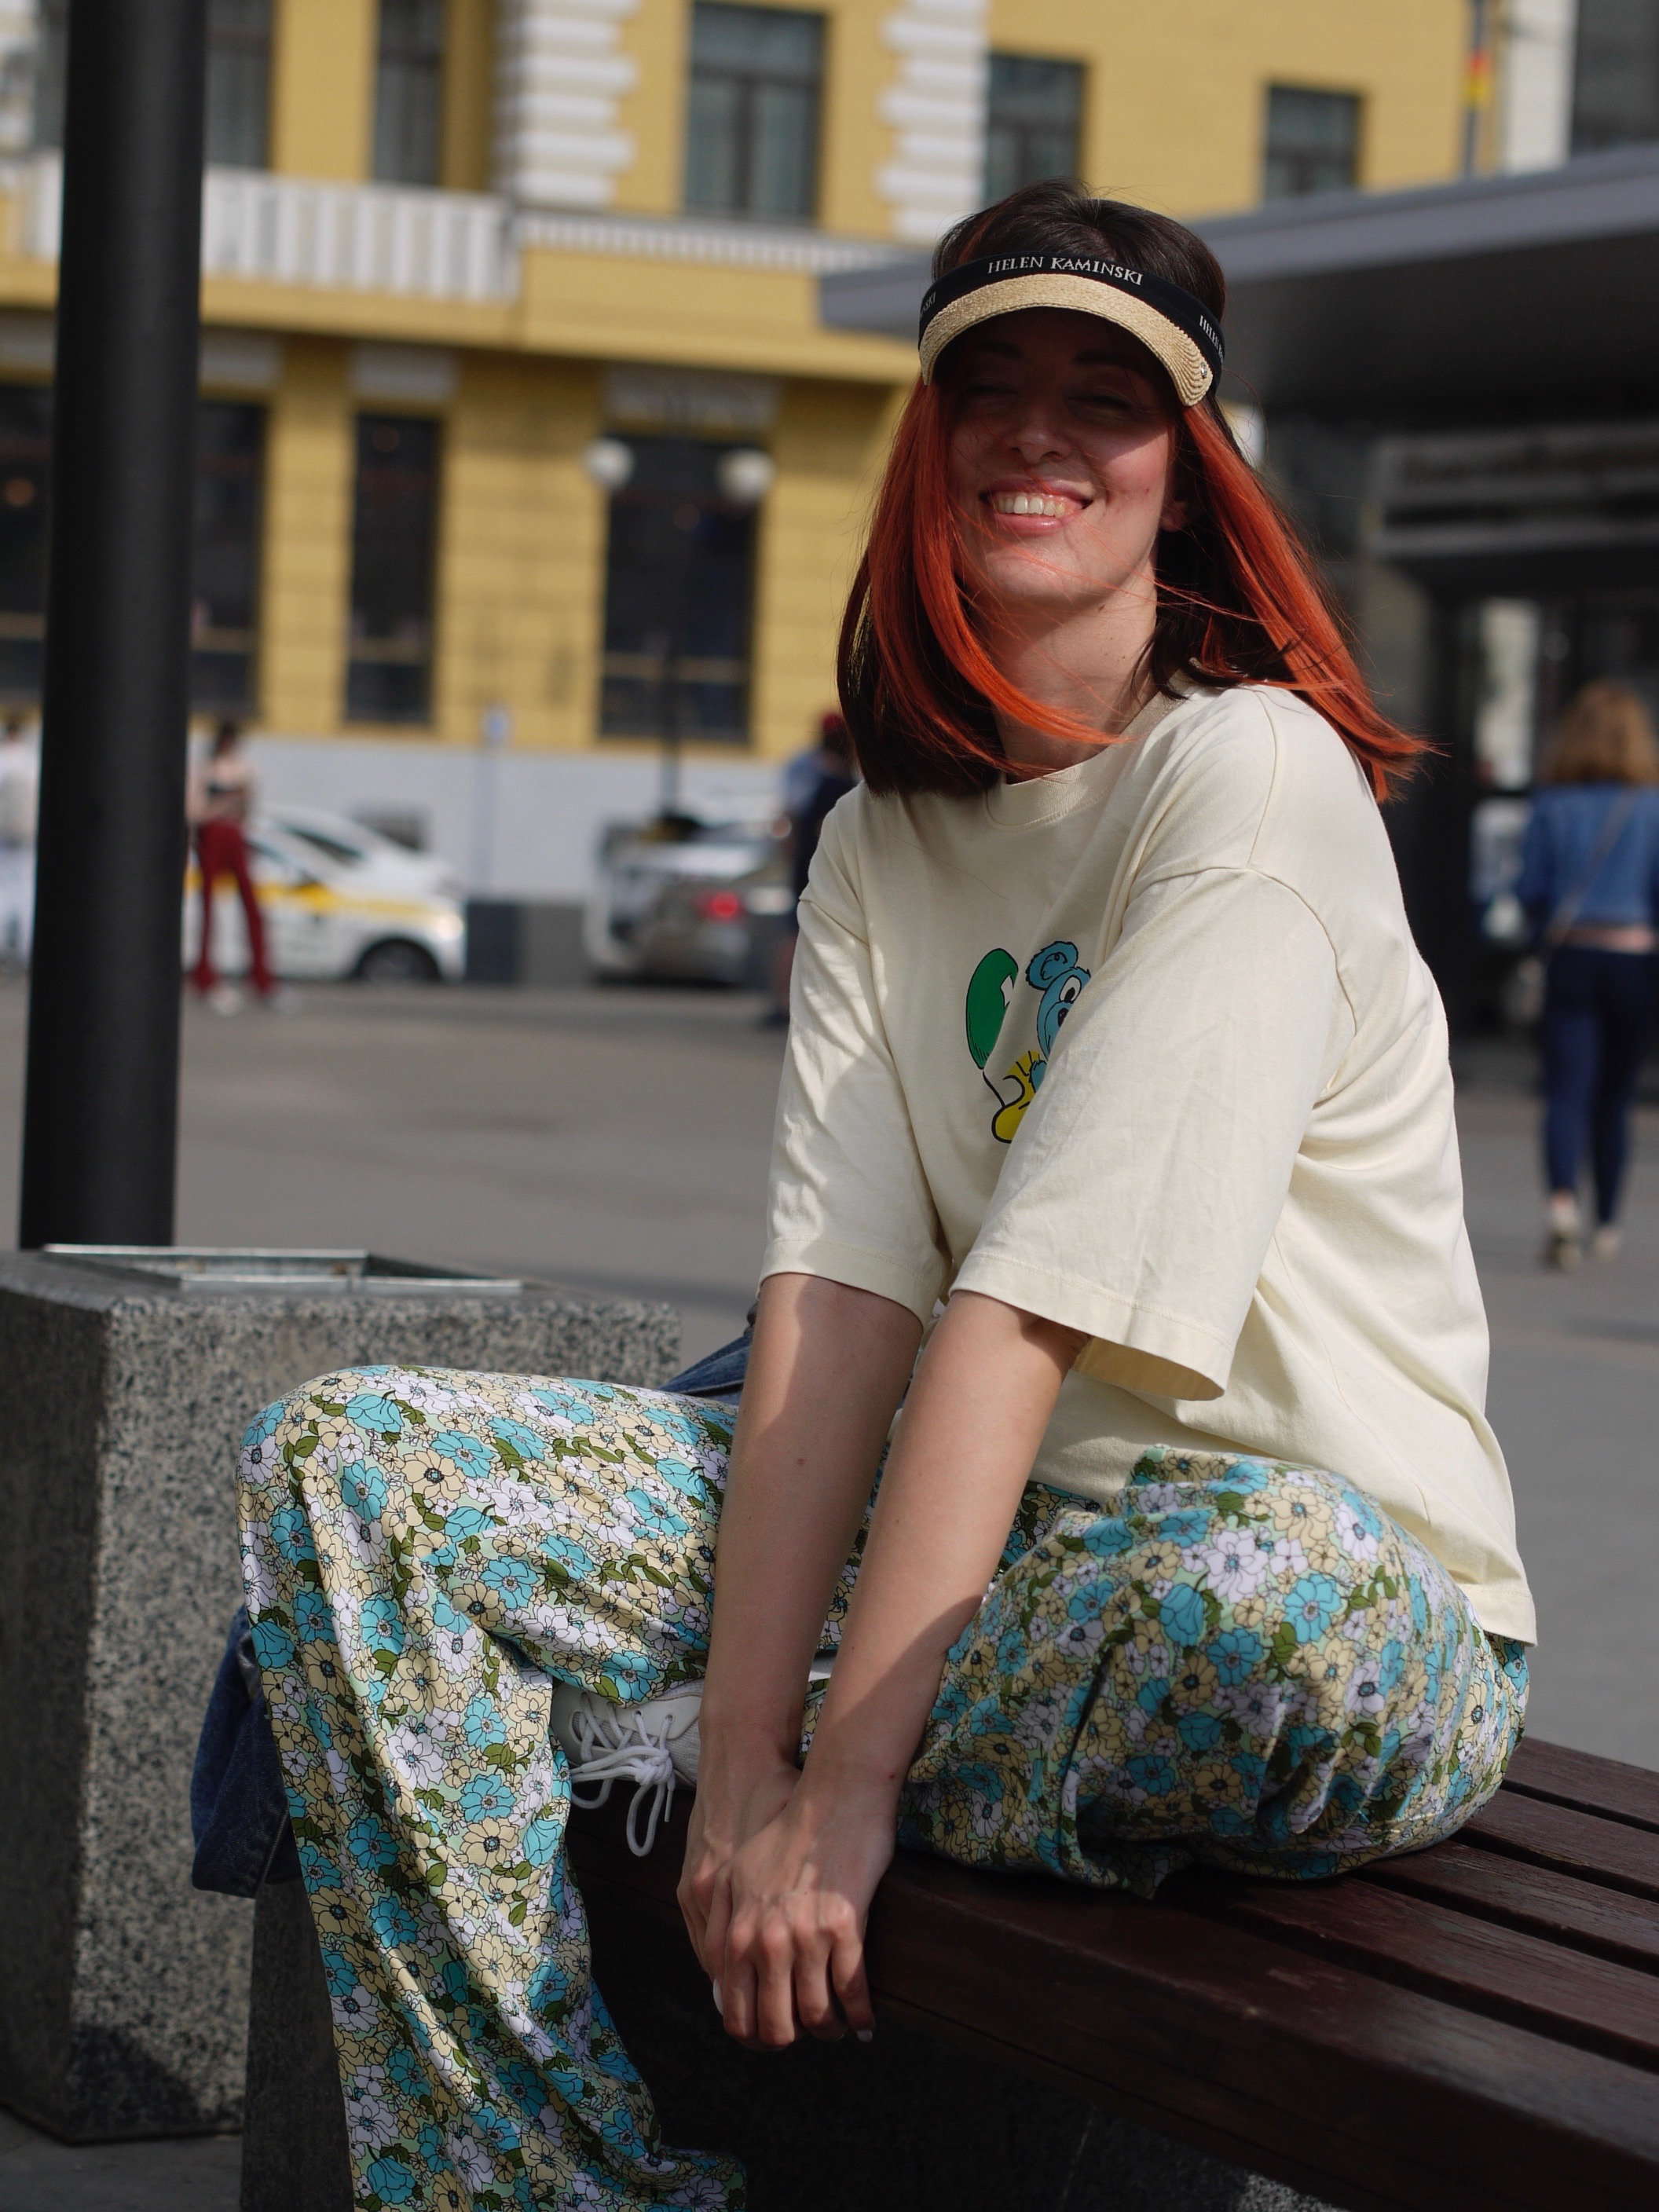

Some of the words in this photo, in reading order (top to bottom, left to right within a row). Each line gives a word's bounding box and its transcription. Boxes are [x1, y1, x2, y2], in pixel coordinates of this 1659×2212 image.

[987, 256, 1044, 274] HELEN
[1050, 257, 1144, 285] KAMINSKI
[1199, 314, 1219, 350] HELEN
